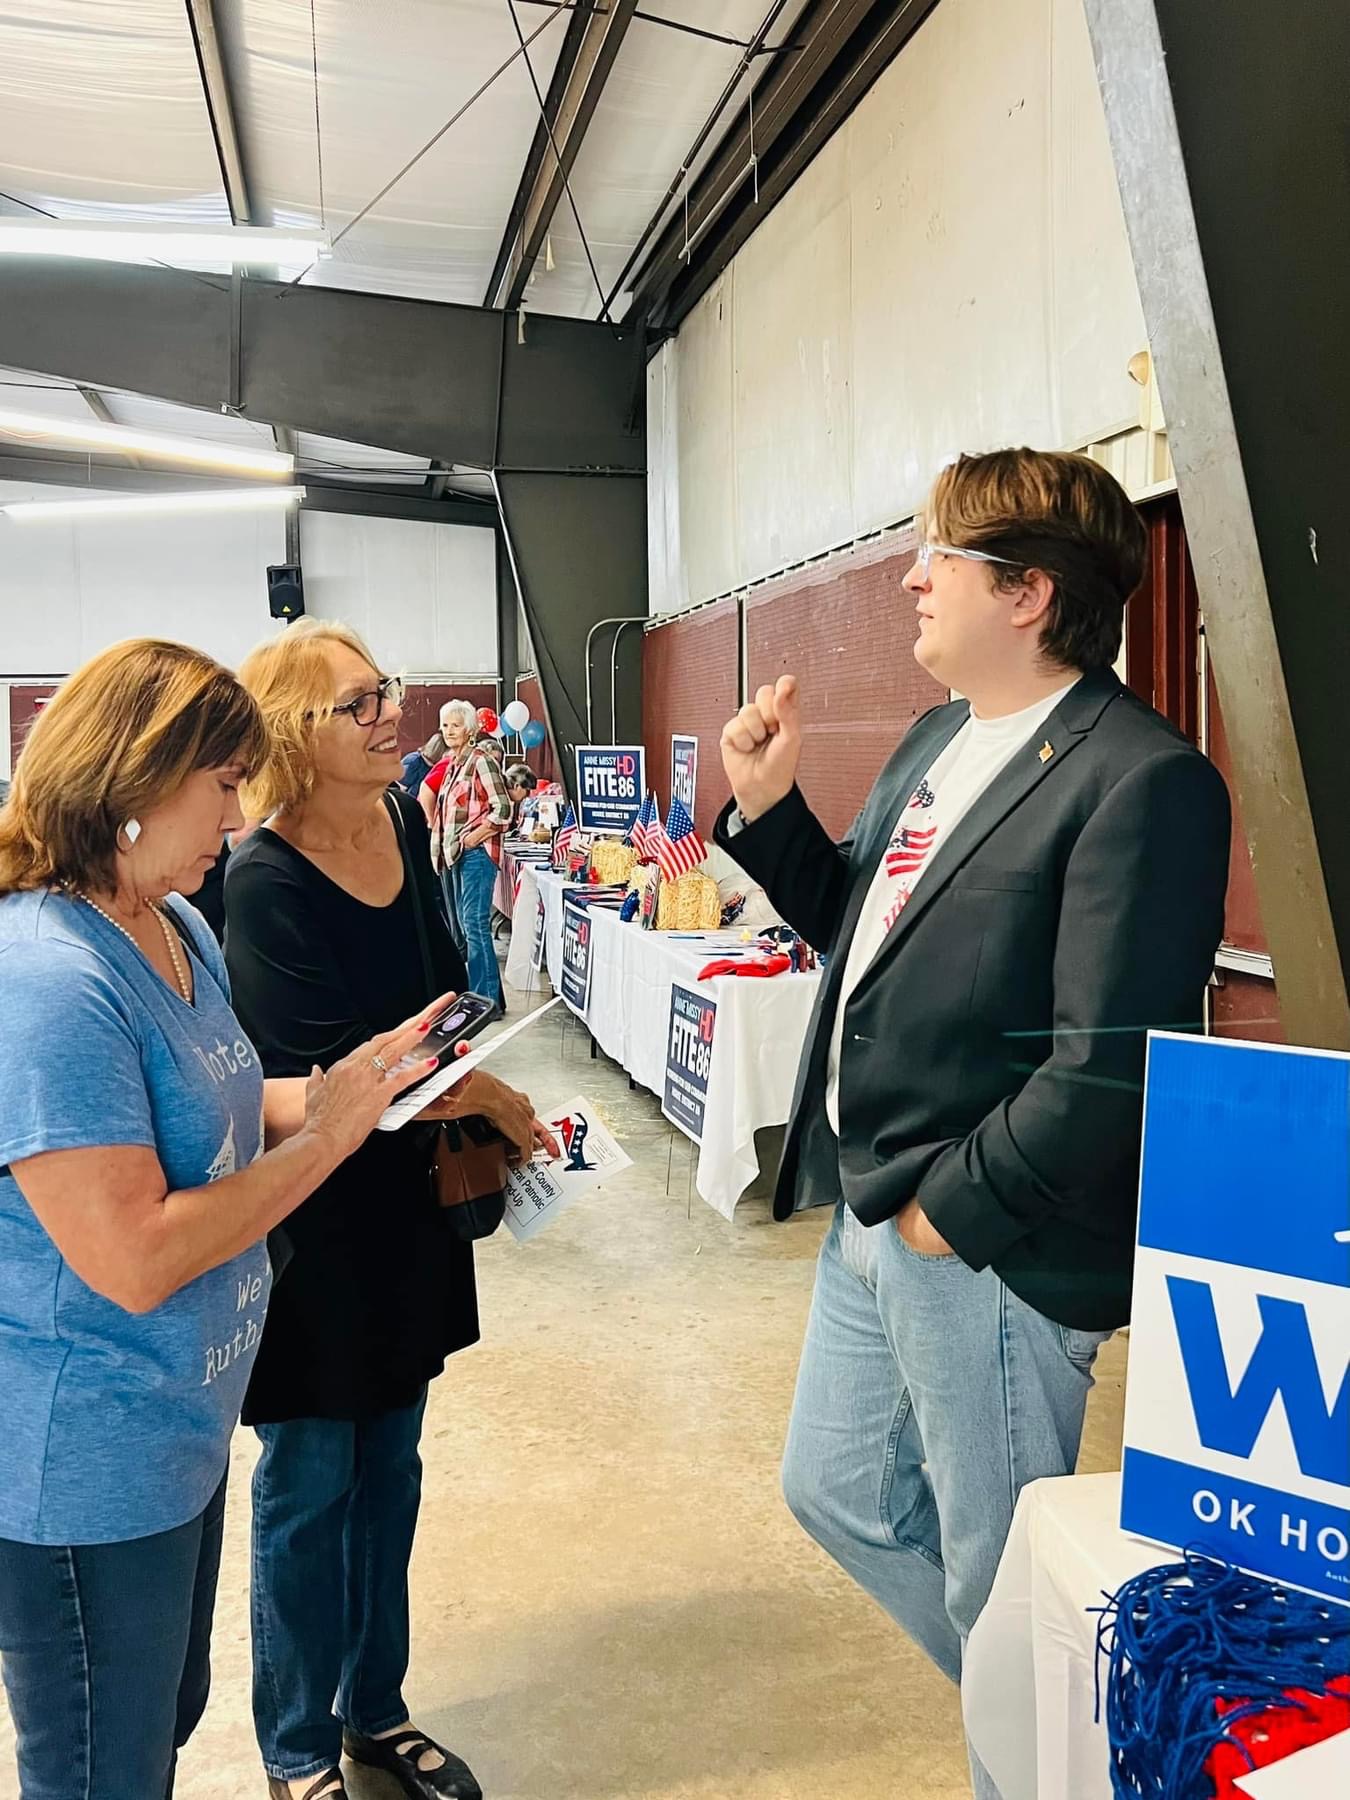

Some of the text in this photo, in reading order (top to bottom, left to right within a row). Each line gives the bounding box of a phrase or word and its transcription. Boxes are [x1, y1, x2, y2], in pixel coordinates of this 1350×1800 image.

[617, 755, 635, 776] HD
[584, 767, 635, 798] FITE 86
[699, 1007, 715, 1042] HD
[671, 1013, 711, 1081] FITE 86
[521, 1179, 545, 1210] Patriotic
[535, 1171, 556, 1198] County
[1165, 1275, 1350, 1488] W
[1192, 1490, 1348, 1561] OK HO
